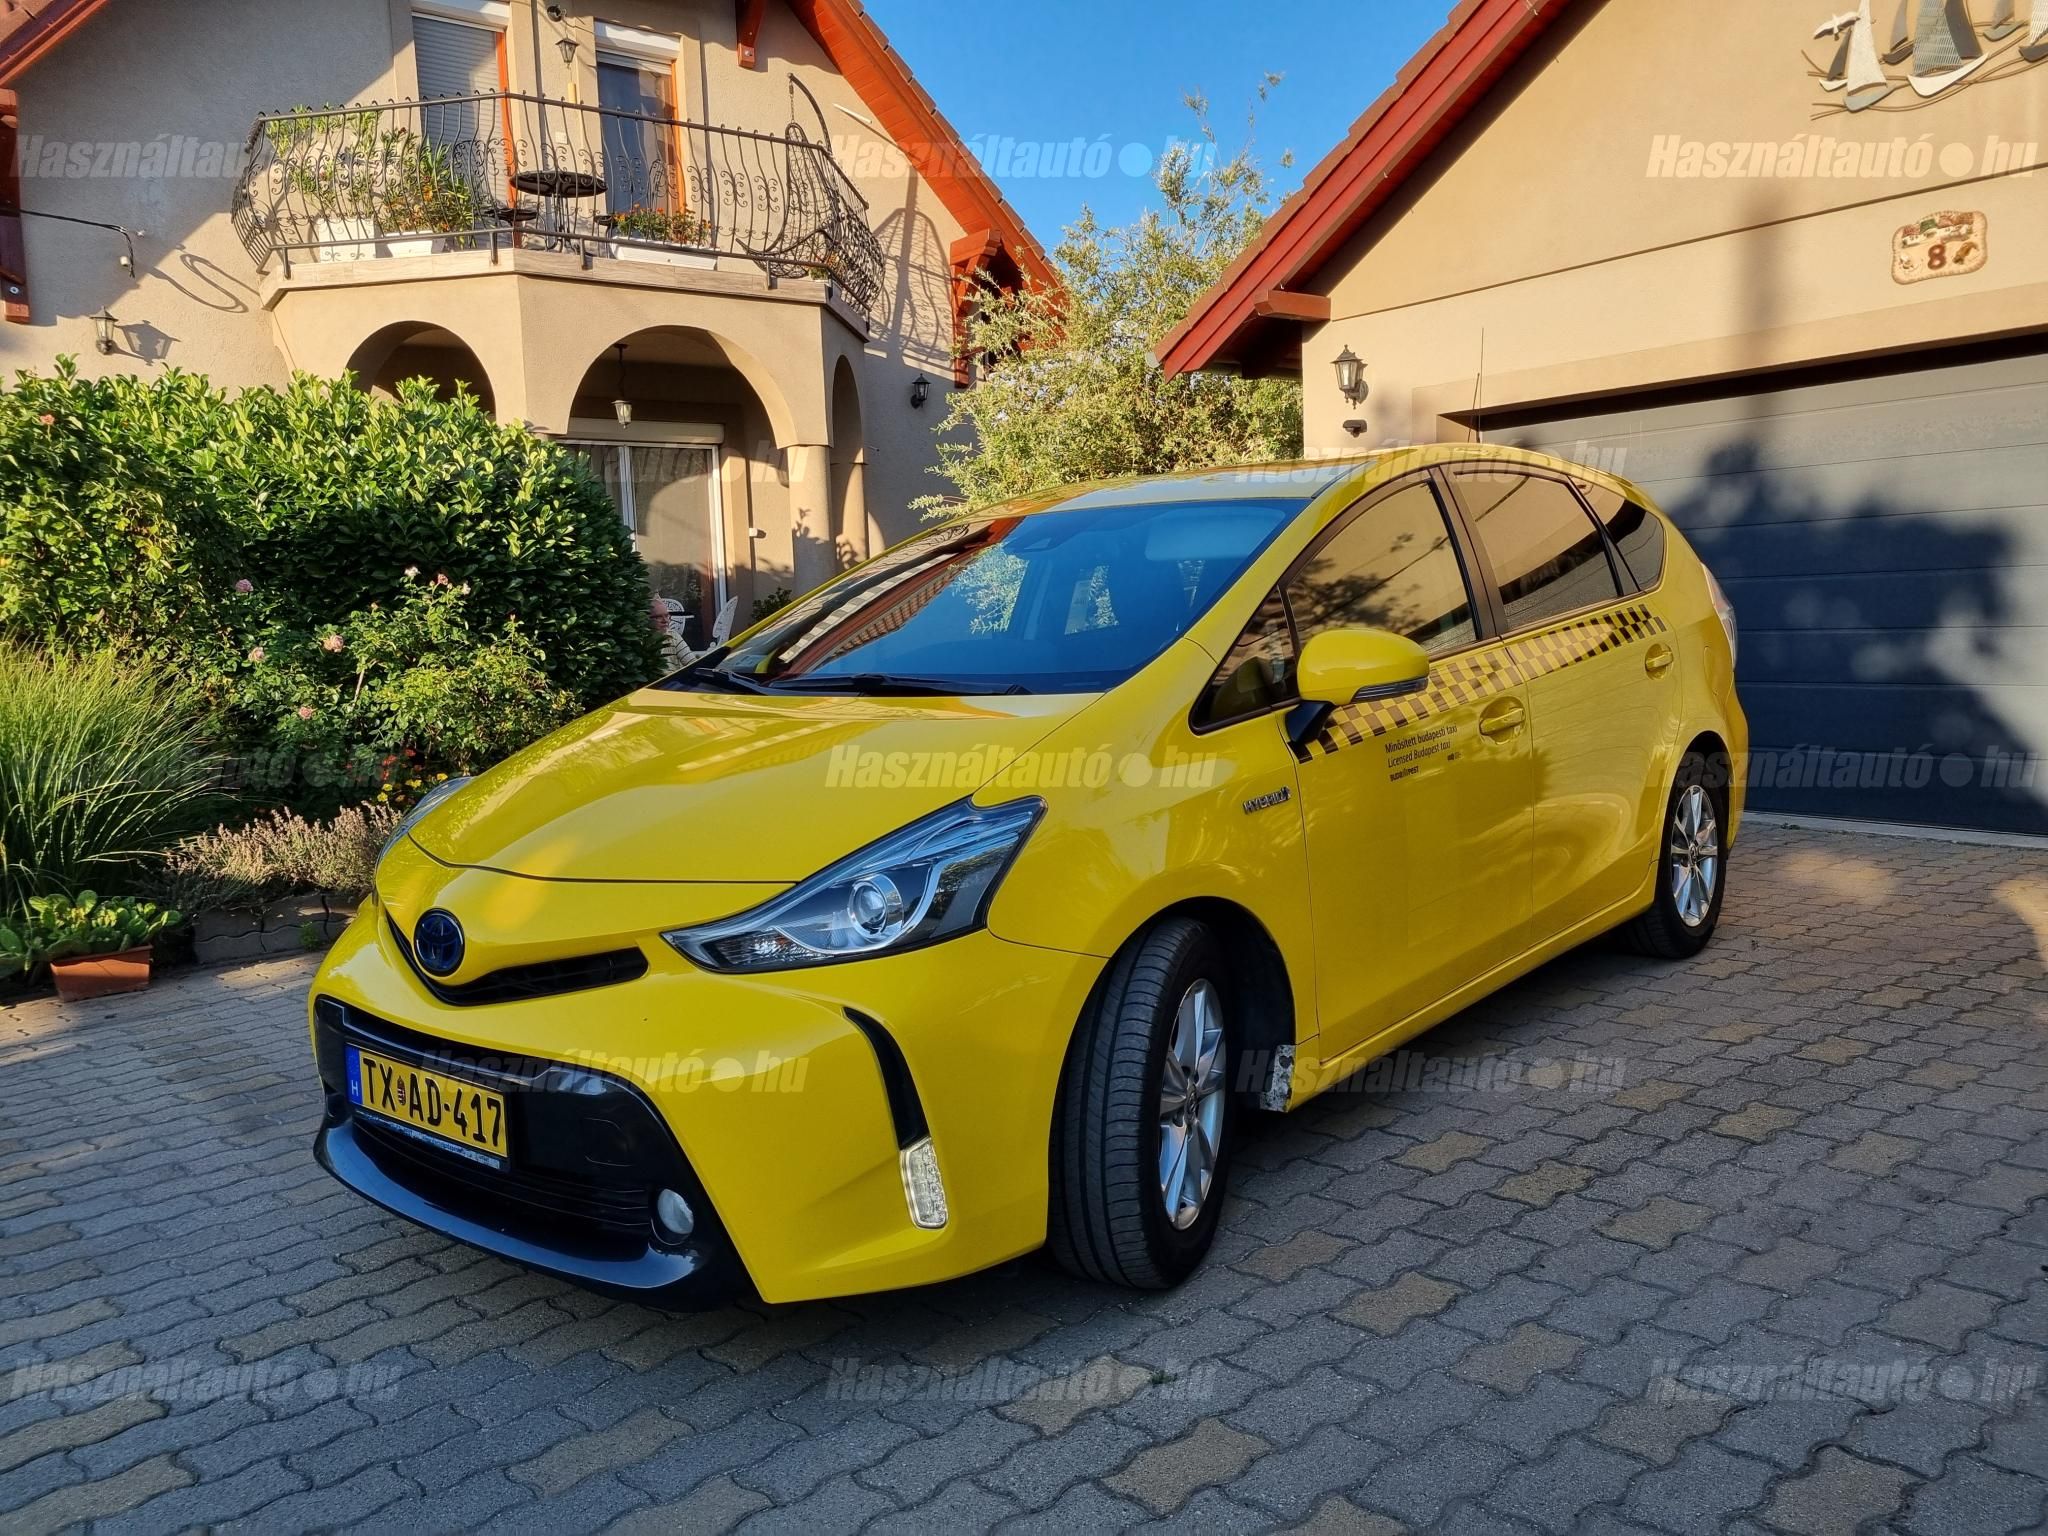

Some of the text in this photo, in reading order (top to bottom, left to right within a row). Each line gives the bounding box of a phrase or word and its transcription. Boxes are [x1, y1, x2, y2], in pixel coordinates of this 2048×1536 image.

[1928, 244, 1947, 270] 8
[1446, 723, 1458, 735] taxi
[1387, 751, 1413, 768] Licensed
[1413, 743, 1440, 759] Budapest
[1440, 740, 1451, 751] taxi
